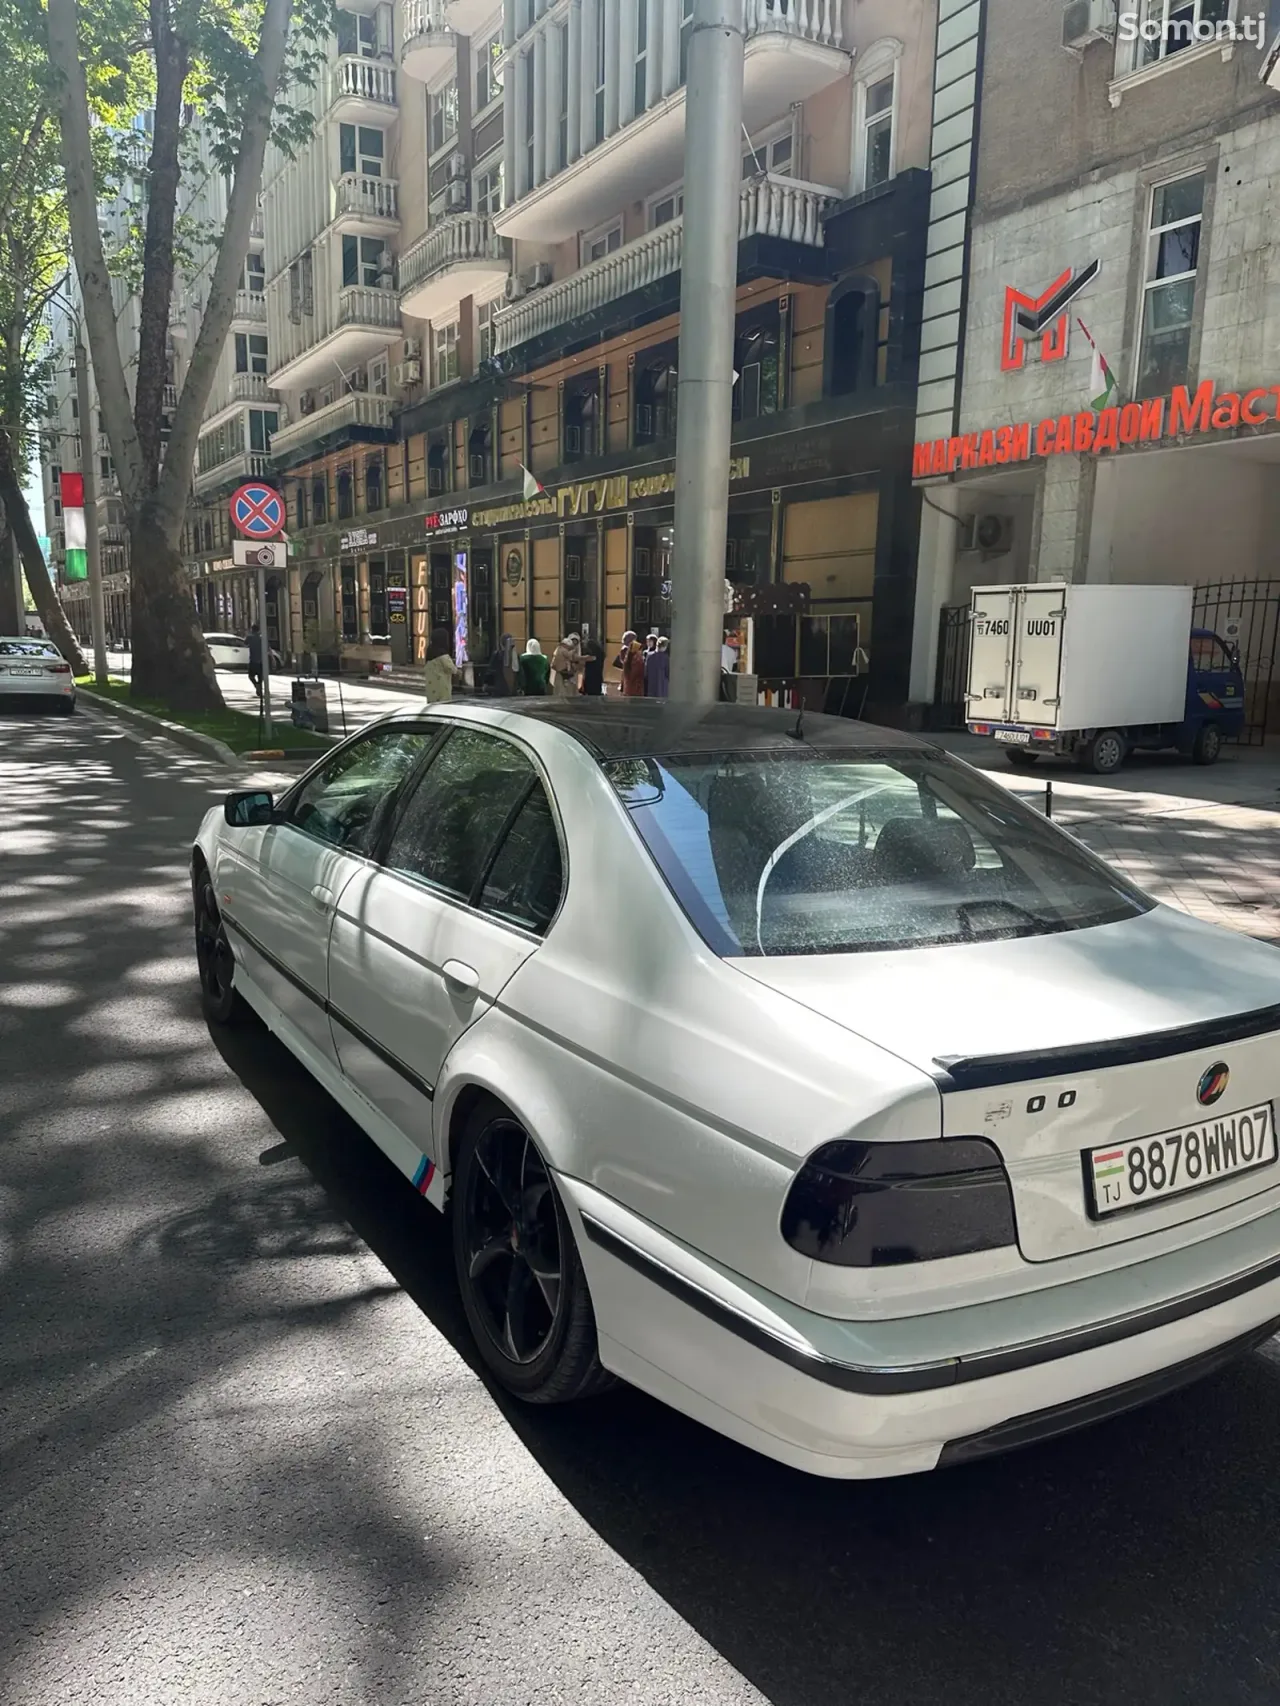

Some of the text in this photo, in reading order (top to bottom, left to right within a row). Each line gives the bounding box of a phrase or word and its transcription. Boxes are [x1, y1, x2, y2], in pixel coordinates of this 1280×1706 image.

[912, 421, 1032, 478] МАРКАЗИ
[1035, 397, 1166, 457] САВДОИ
[557, 475, 628, 518] ГУГУШ
[417, 560, 427, 659] FOUR
[985, 620, 1009, 635] 7460
[1027, 620, 1056, 636] UU01
[1102, 1110, 1268, 1204] TJ 8878WW07
